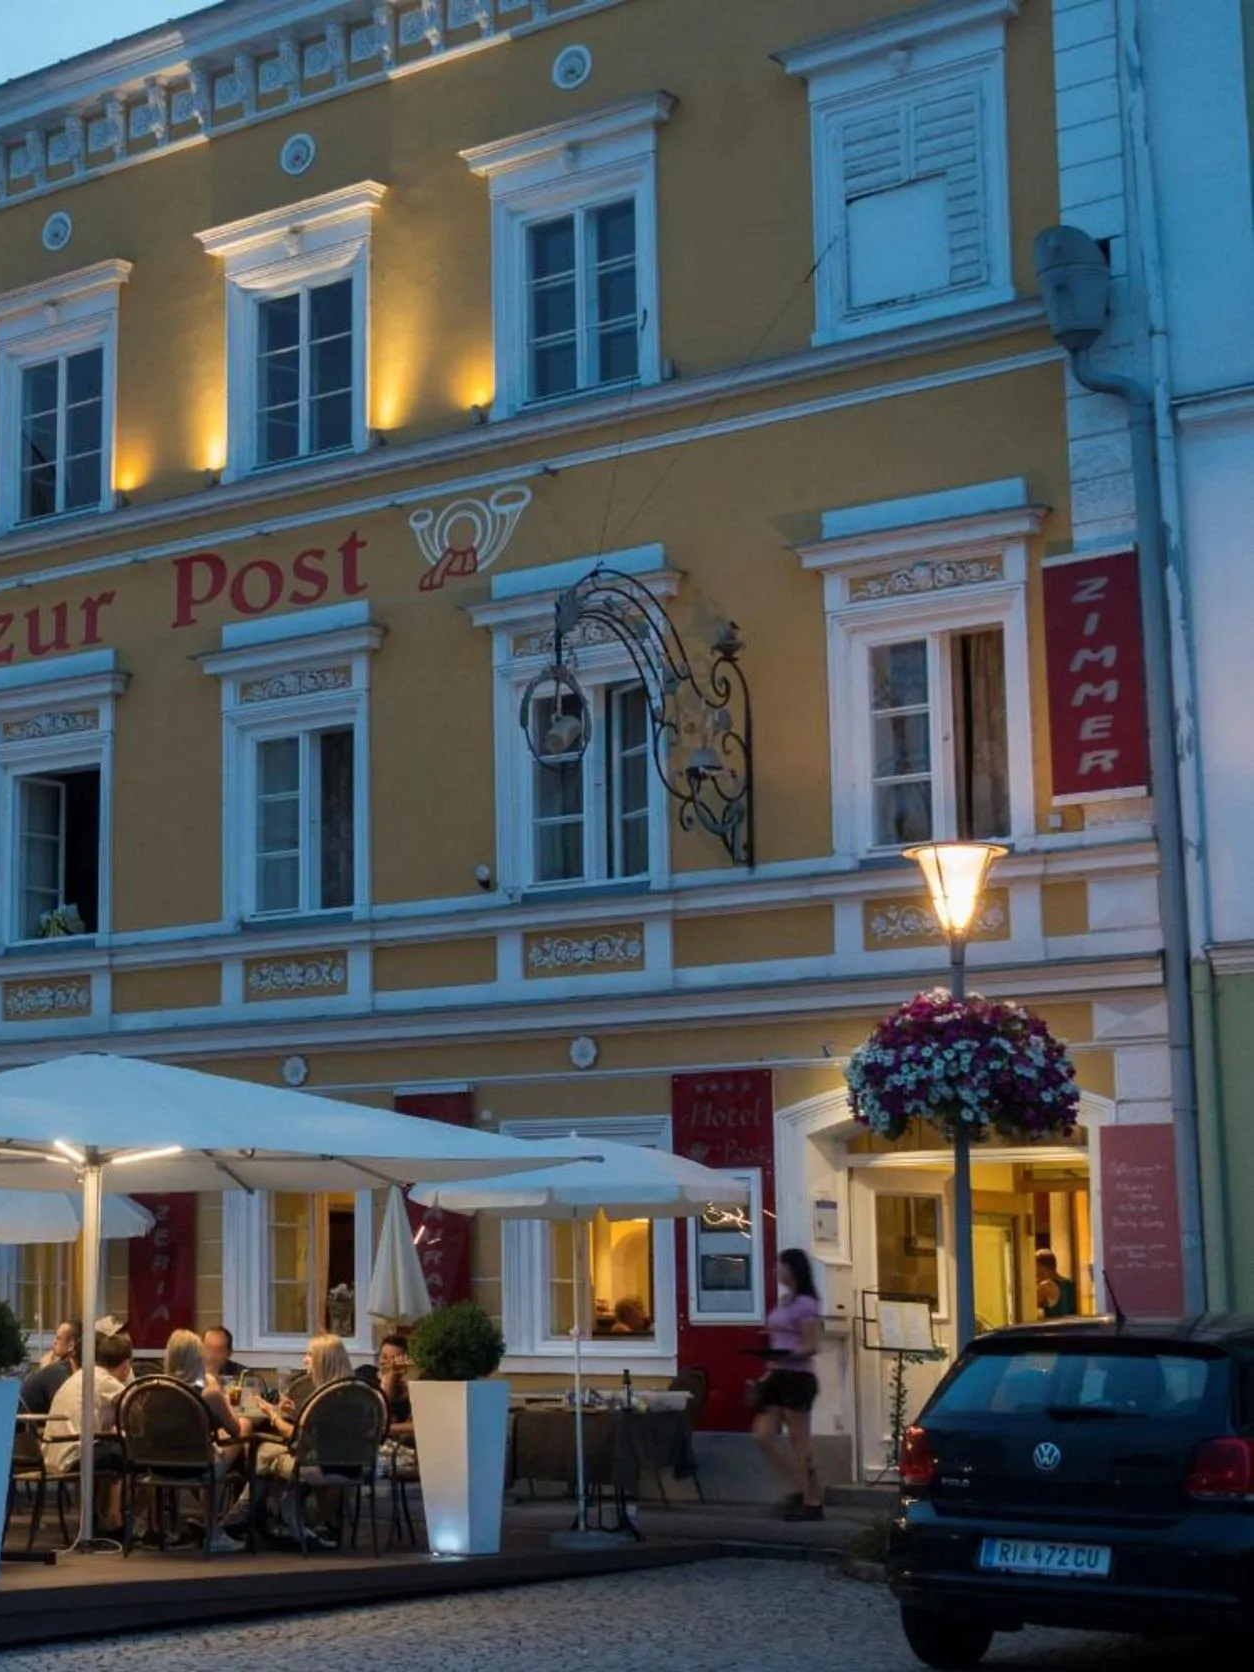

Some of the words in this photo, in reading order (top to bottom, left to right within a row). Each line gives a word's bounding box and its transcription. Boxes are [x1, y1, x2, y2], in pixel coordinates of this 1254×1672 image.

[170, 530, 369, 629] Post
[1069, 576, 1120, 776] ZIMMER
[683, 1096, 762, 1129] Hotel
